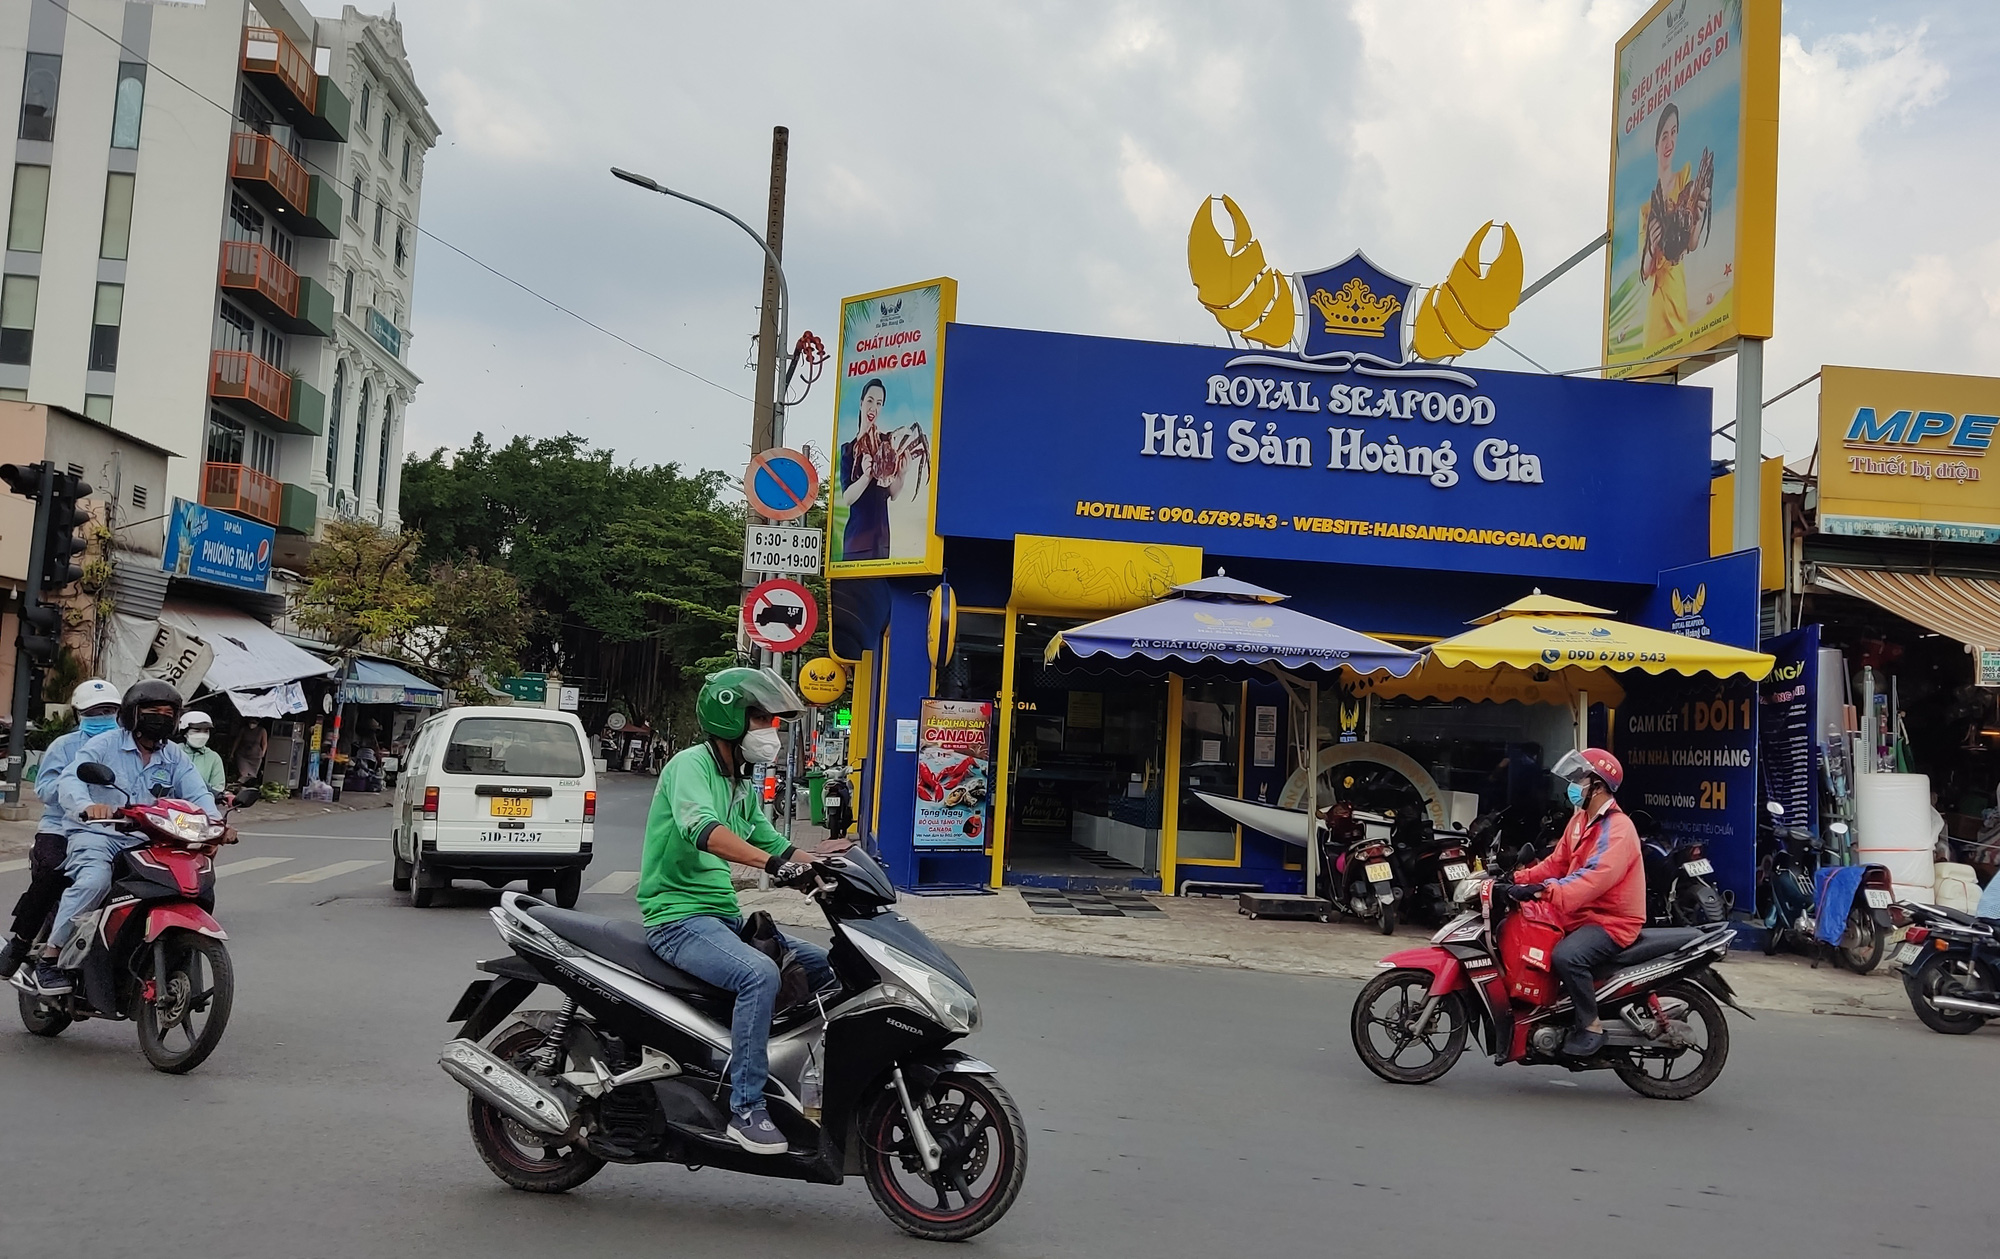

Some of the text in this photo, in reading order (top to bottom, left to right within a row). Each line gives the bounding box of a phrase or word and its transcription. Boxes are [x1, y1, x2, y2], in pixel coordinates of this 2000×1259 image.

[1631, 74, 1653, 106] SIÊU
[1655, 56, 1672, 84] THỊ
[1674, 35, 1694, 67] HẢI
[1697, 10, 1723, 46] SẢN
[1625, 31, 1728, 134] CHẾ BIẾN MANG ĐI
[856, 330, 921, 352] CHẤT LƯỢNG
[848, 350, 927, 377] HOÀNG GIA
[1206, 376, 1496, 426] ROYAL SEAFOOD
[1843, 406, 2000, 449] MPE
[1141, 412, 1545, 488] Hải Sản Hoàng Gia
[1848, 455, 1981, 485] Thiết bị điện
[223, 520, 232, 534] TẠP
[1075, 501, 1154, 523] HOTLINE:
[1158, 507, 1278, 530] 090.6789.543
[1293, 516, 1586, 551] WEBSITE:HAISANHOANGGIA.COM
[202, 540, 254, 571] PHƯƠNG THẢO
[750, 551, 817, 568] 17:00-19:00
[1131, 638, 1149, 648] ĂN
[1152, 639, 1185, 649] CHẤT
[1187, 641, 1227, 653] LƯỢNG
[1271, 646, 1306, 657] THỊNH
[1308, 648, 1350, 660] VƯỢNG
[1567, 650, 1666, 663] 090 6789 543
[1017, 701, 1037, 710] GIA
[1629, 715, 1655, 733] CAM
[1657, 707, 1678, 732] KẾT
[1681, 702, 1690, 731] 1
[1740, 698, 1750, 730] 1
[925, 728, 985, 744] CANADA
[1672, 746, 1711, 767] KHÁCH
[1713, 745, 1751, 768] HÀNG
[503, 798, 522, 807] 51D
[1645, 781, 1726, 810] TRONG VÒNG 2H
[496, 807, 528, 815] 172.97
[942, 809, 963, 817] Ngay
[480, 832, 542, 842] 51D-172.97
[111, 894, 134, 903] HONDA
[1464, 958, 1492, 969] YAMAHA
[554, 965, 622, 1004] AIR BLADE
[886, 1017, 924, 1036] HONDA
